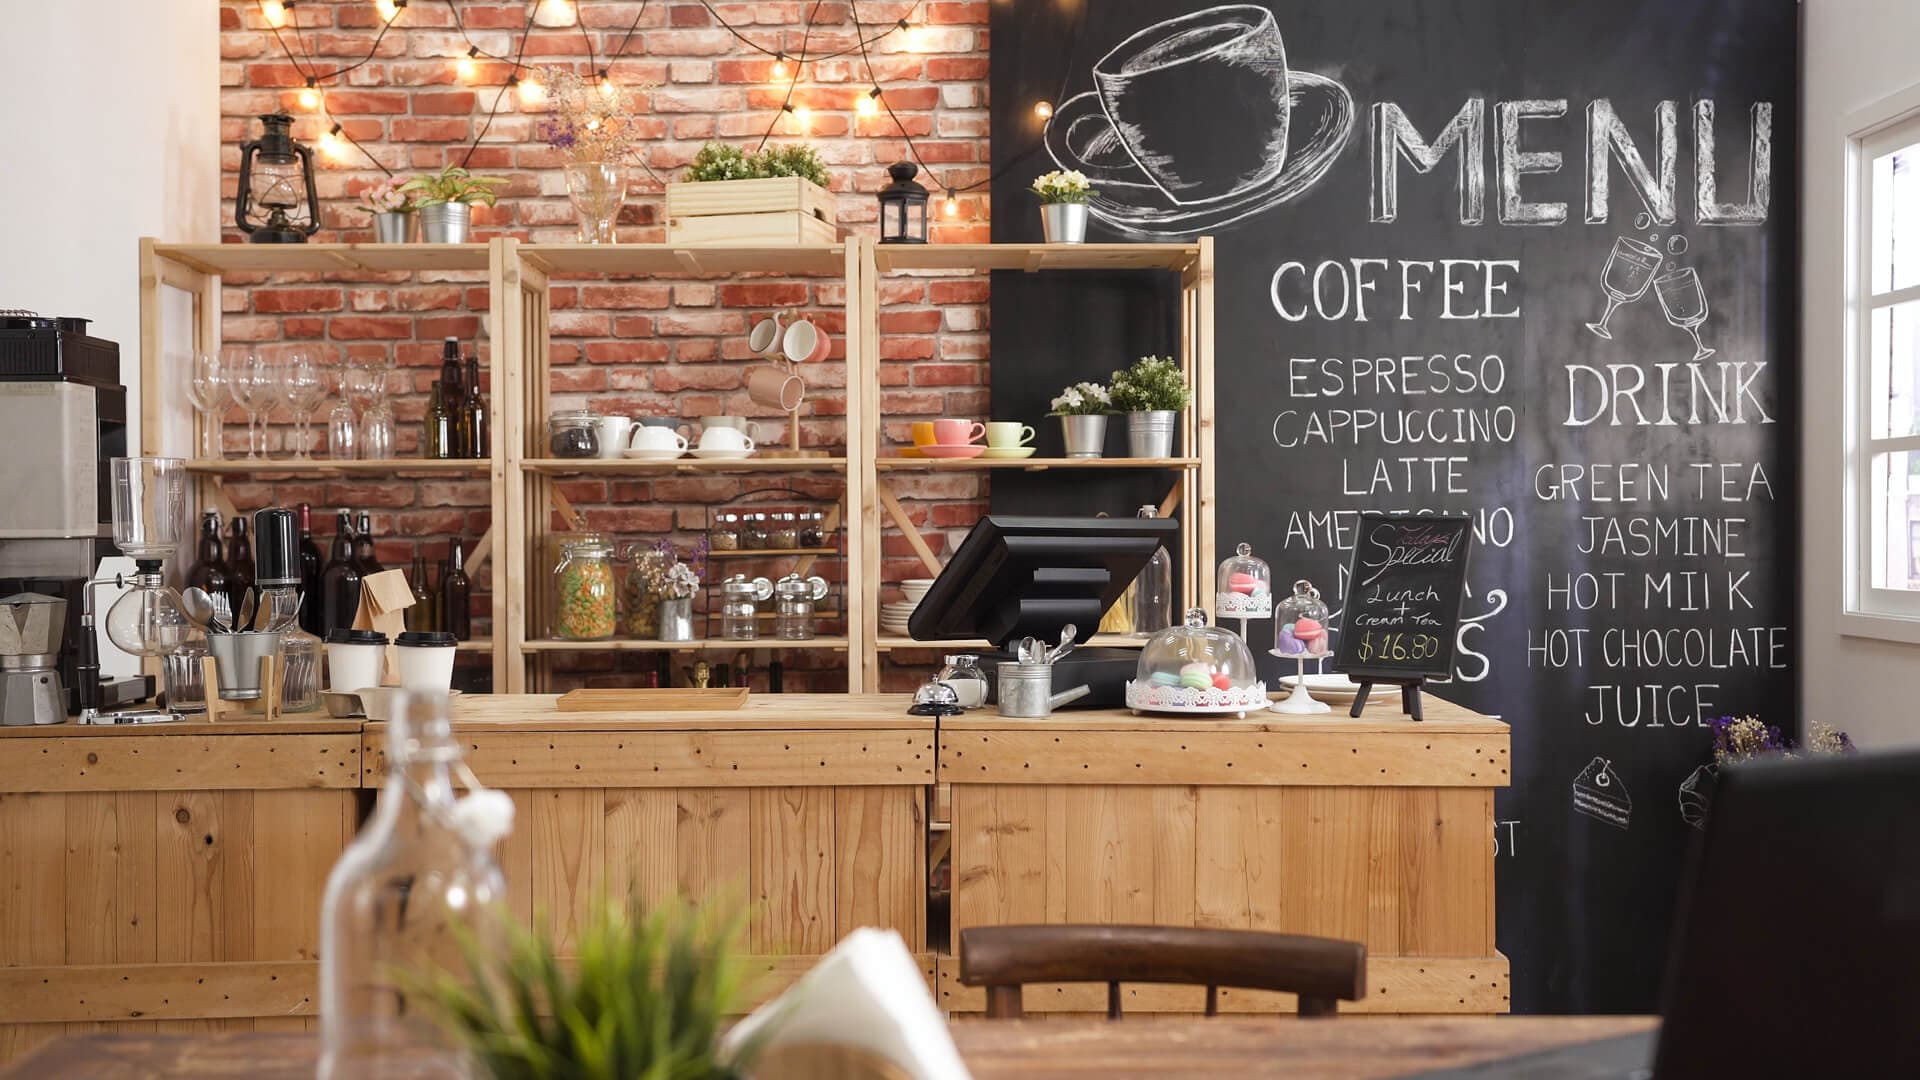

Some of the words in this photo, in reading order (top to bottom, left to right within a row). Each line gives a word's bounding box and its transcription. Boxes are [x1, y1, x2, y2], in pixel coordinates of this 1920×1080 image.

[1369, 98, 1774, 226] MENU
[1270, 257, 1521, 322] COFFEE
[1289, 353, 1505, 398] ESPRESSO
[1562, 360, 1777, 427] DRINK
[1272, 405, 1516, 448] CAPPUCCINO
[1343, 457, 1469, 496] LATTE
[1534, 463, 1669, 503] GREEN
[1696, 462, 1775, 502] TEA
[1284, 507, 1514, 550] AMENO
[1577, 516, 1747, 558] JASMINE
[1361, 523, 1463, 586] Special
[1366, 583, 1441, 604] Lunch
[1547, 572, 1625, 611] HOT
[1355, 613, 1404, 626] Cream
[1411, 612, 1443, 626] Tea
[1527, 628, 1592, 668] HOT
[1602, 627, 1788, 669] CHOCOLATE
[1584, 683, 1720, 728] JUICE
